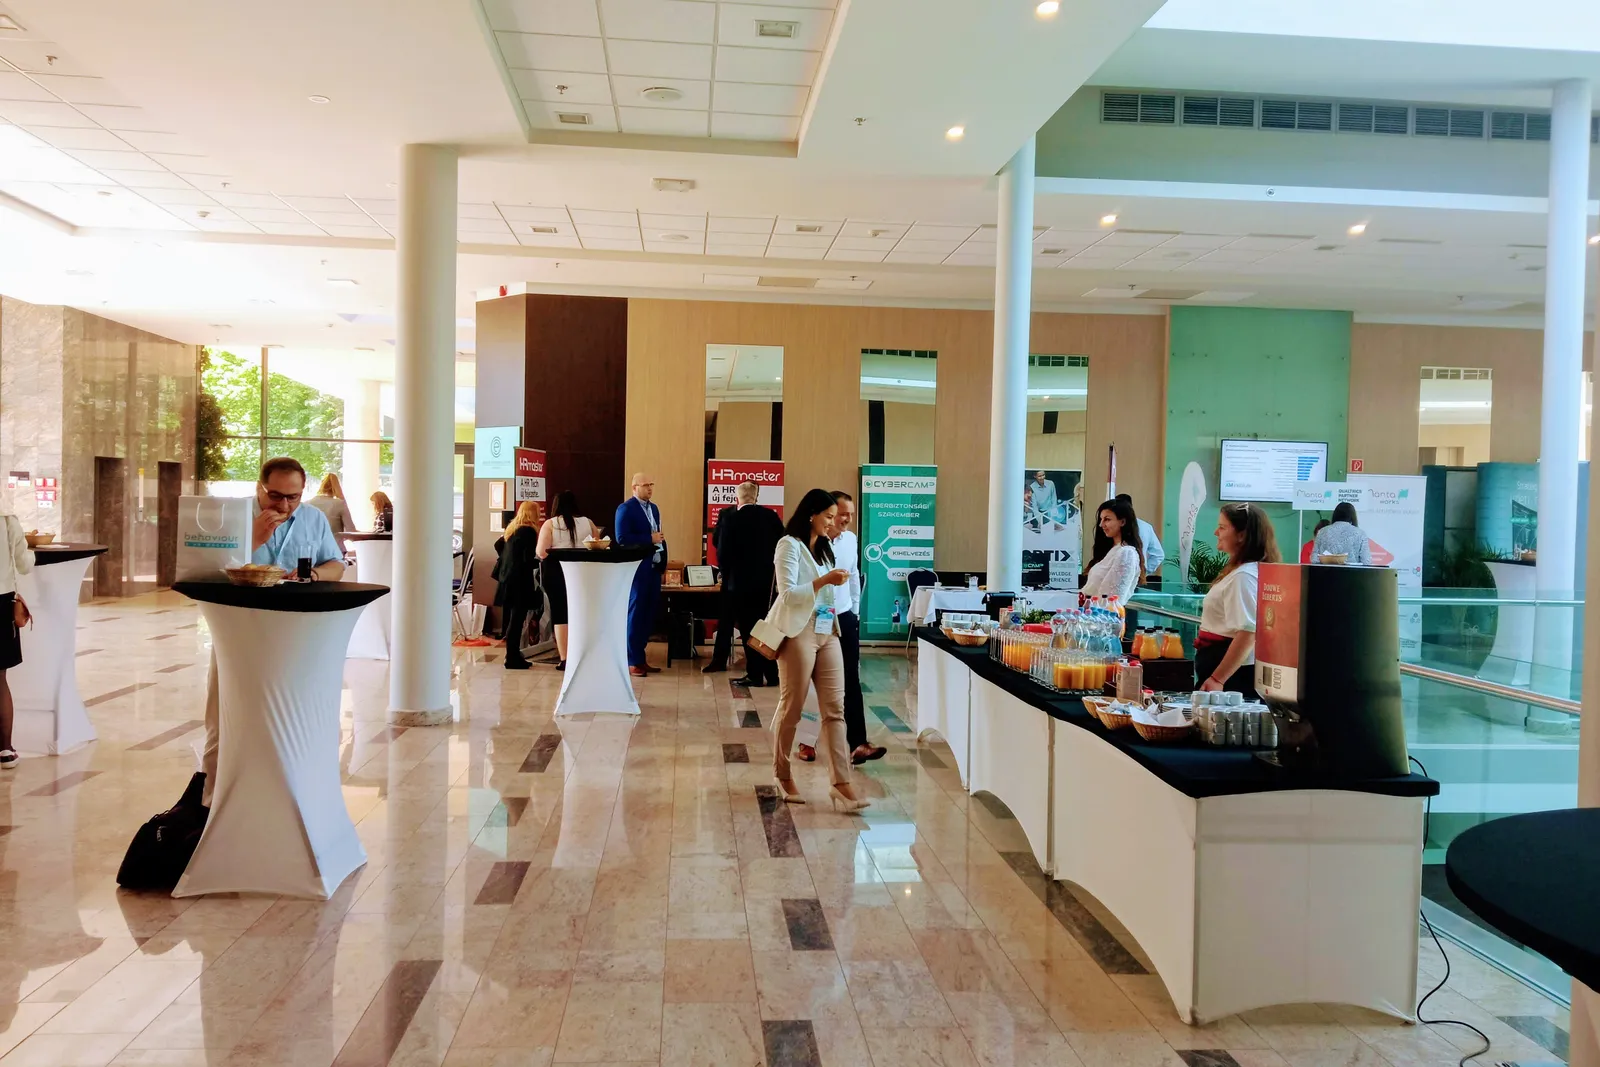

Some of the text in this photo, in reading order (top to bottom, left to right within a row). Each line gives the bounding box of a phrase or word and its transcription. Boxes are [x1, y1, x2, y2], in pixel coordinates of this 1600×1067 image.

[519, 457, 543, 472] HRmaster
[712, 469, 780, 481] HRmaster
[874, 480, 935, 489] CYBERCAMP
[712, 494, 720, 502] új
[184, 532, 238, 541] behaviour
